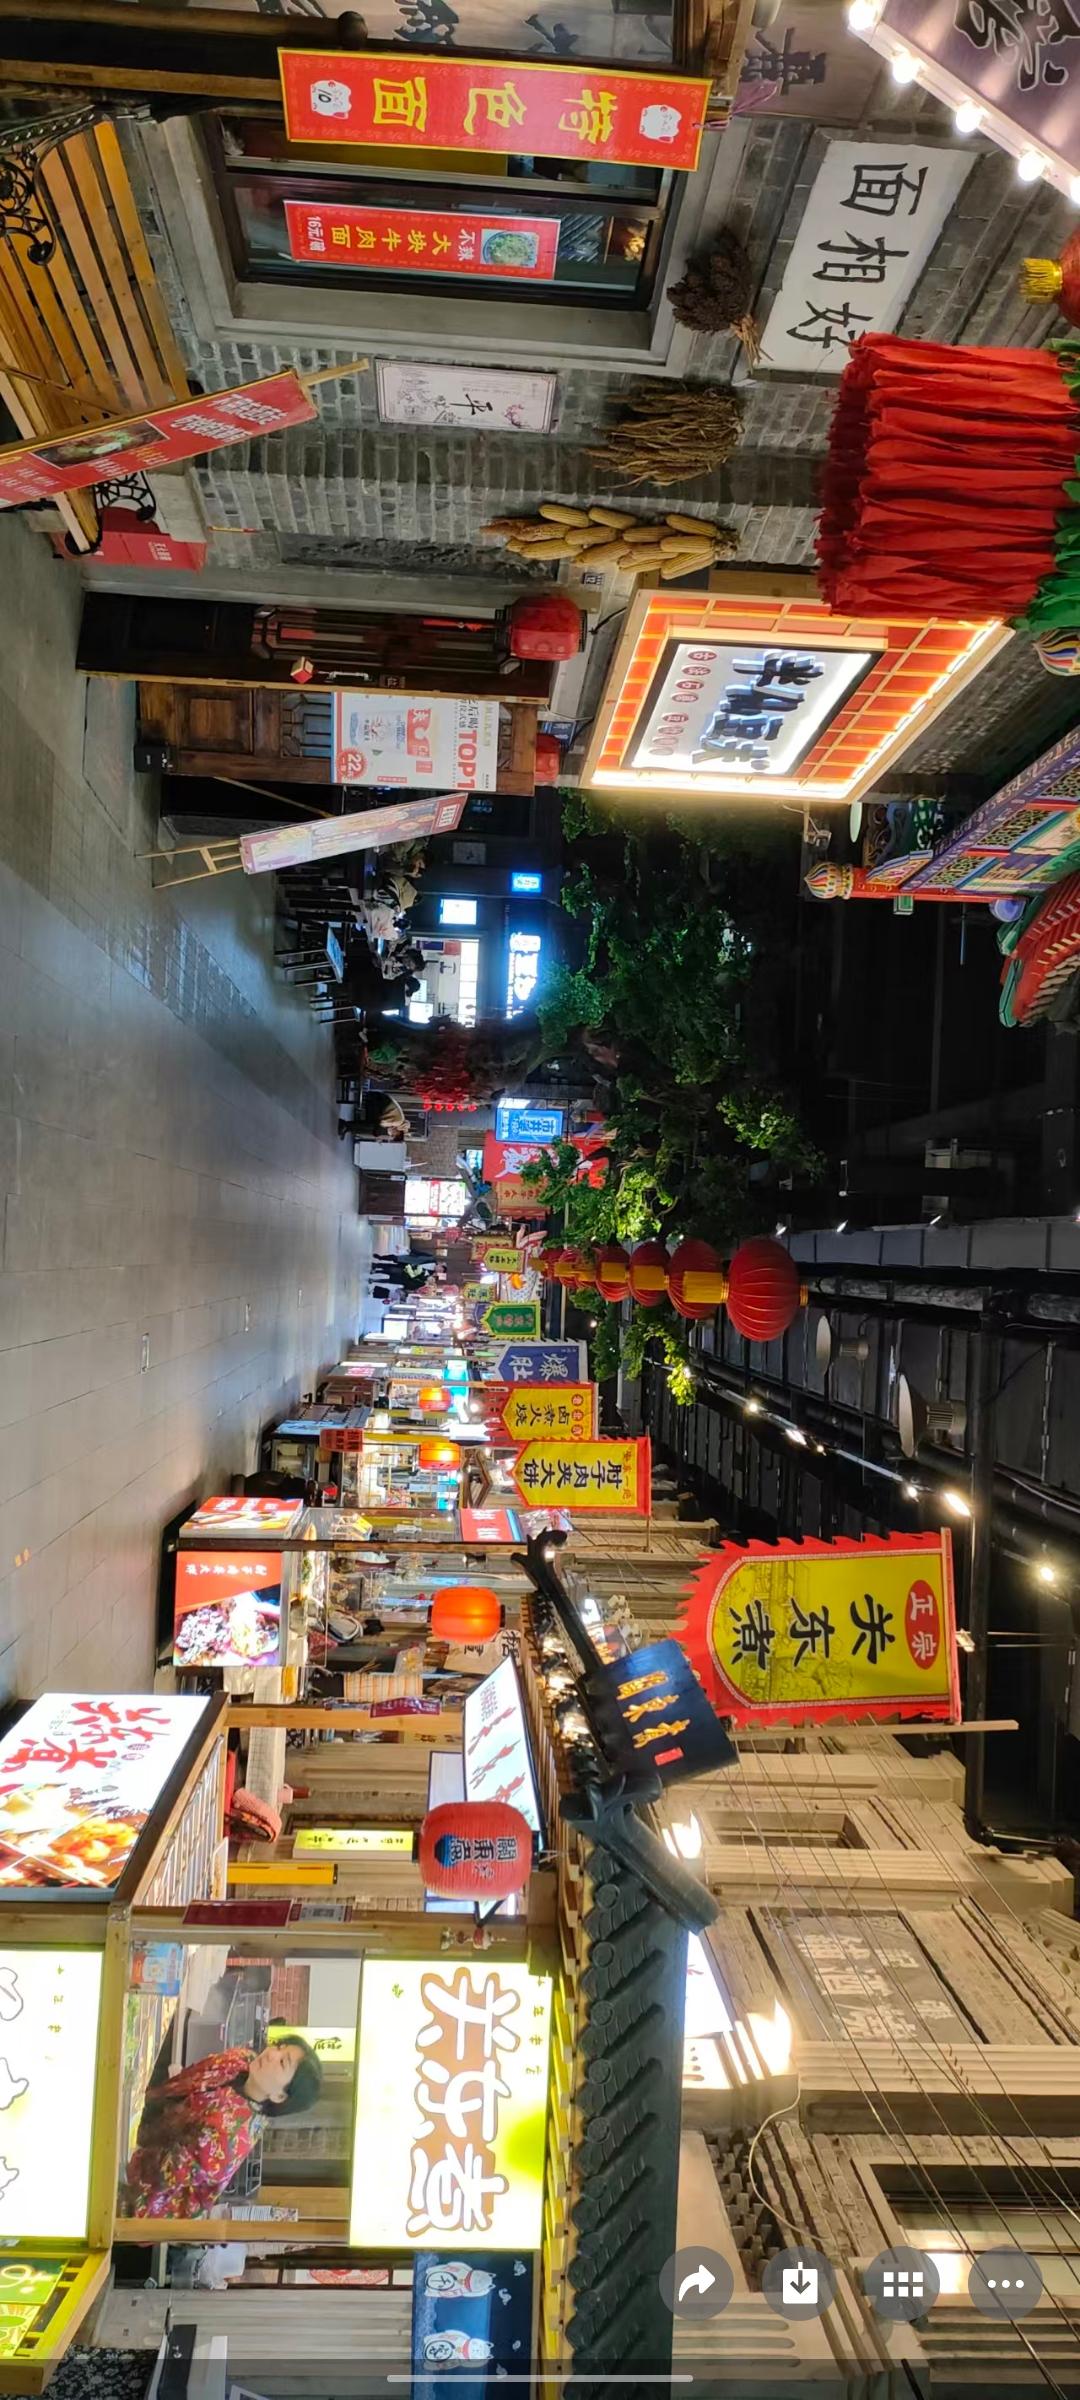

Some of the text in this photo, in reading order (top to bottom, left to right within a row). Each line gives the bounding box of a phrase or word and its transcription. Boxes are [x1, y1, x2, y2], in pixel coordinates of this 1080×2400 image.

[372, 76, 618, 146] 特色面
[330, 224, 452, 256] 大块牛肉面
[456, 228, 476, 262] 不辣
[786, 163, 929, 350] 面相好
[457, 730, 477, 789] TOP1
[508, 1353, 568, 1381] 爆肚
[516, 1403, 570, 1427] 卤煮火烧
[523, 1458, 622, 1489] 肘子肉夹大饼
[730, 1594, 896, 1670] 关东煮
[911, 1592, 934, 1661] 正宗
[407, 1975, 519, 2236] 关东煮
